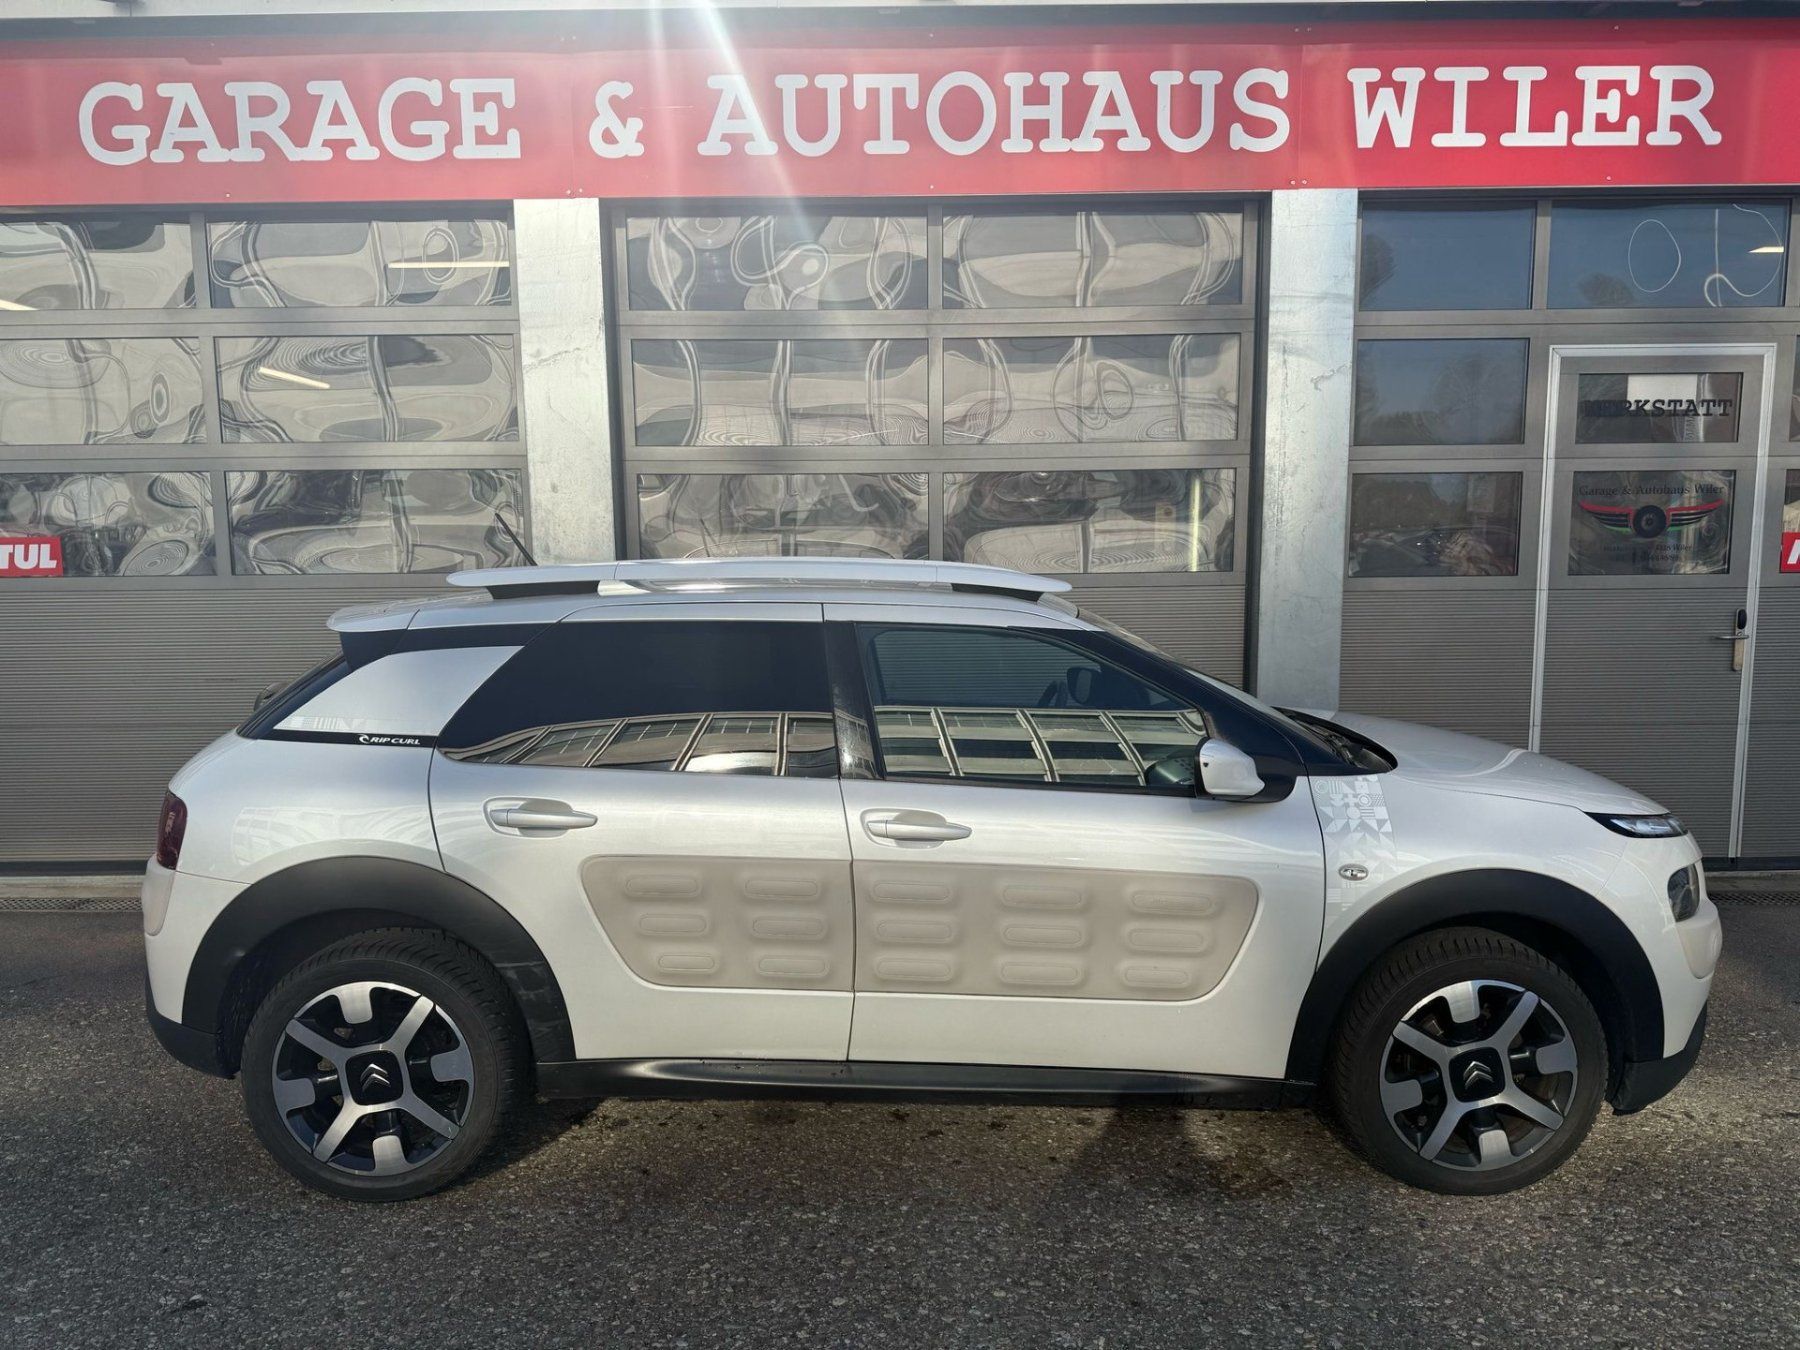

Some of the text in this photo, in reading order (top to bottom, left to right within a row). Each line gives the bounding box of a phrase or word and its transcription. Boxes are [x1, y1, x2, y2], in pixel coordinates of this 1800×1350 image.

[79, 65, 1722, 166] GARAGE & AUTOHAUS WILER
[1582, 399, 1732, 417] RKSTATT
[1579, 483, 1725, 497] Garage & Autohaus Wiler
